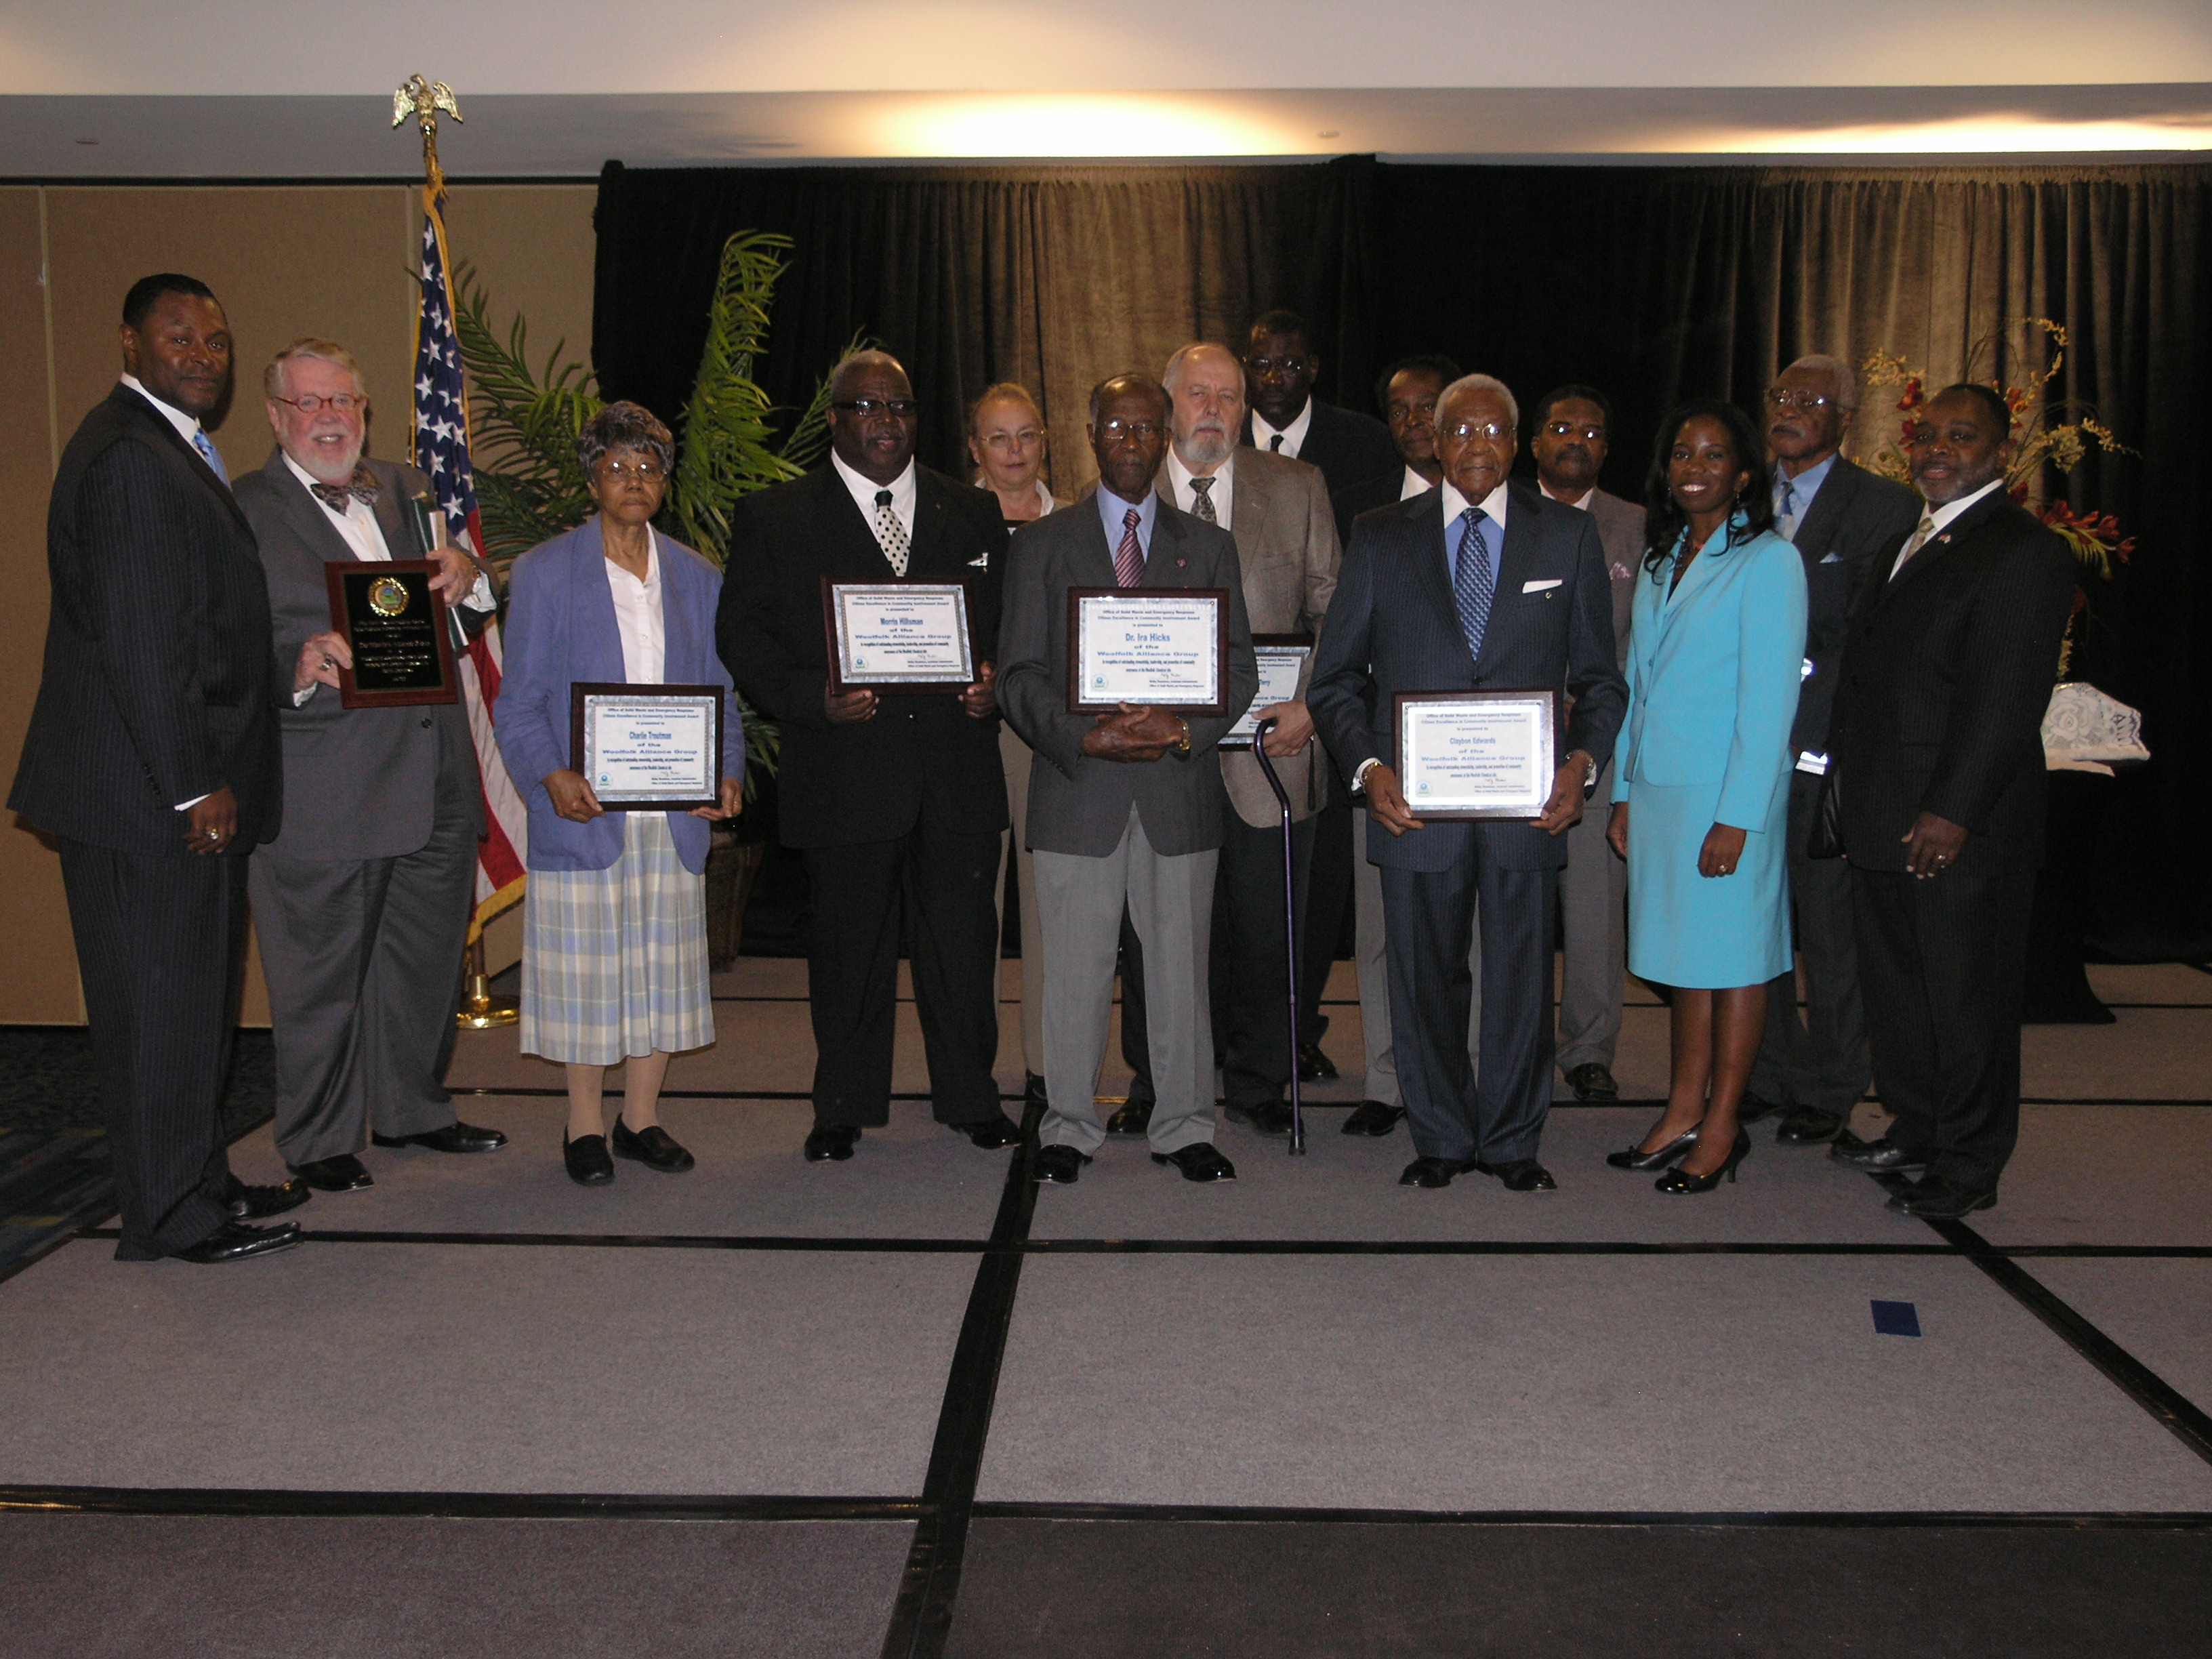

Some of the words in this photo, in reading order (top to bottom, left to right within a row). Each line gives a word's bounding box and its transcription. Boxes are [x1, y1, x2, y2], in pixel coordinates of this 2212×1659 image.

[1125, 633, 1135, 642] Dr.
[1137, 633, 1147, 642] Ira
[1149, 633, 1170, 642] Hicks
